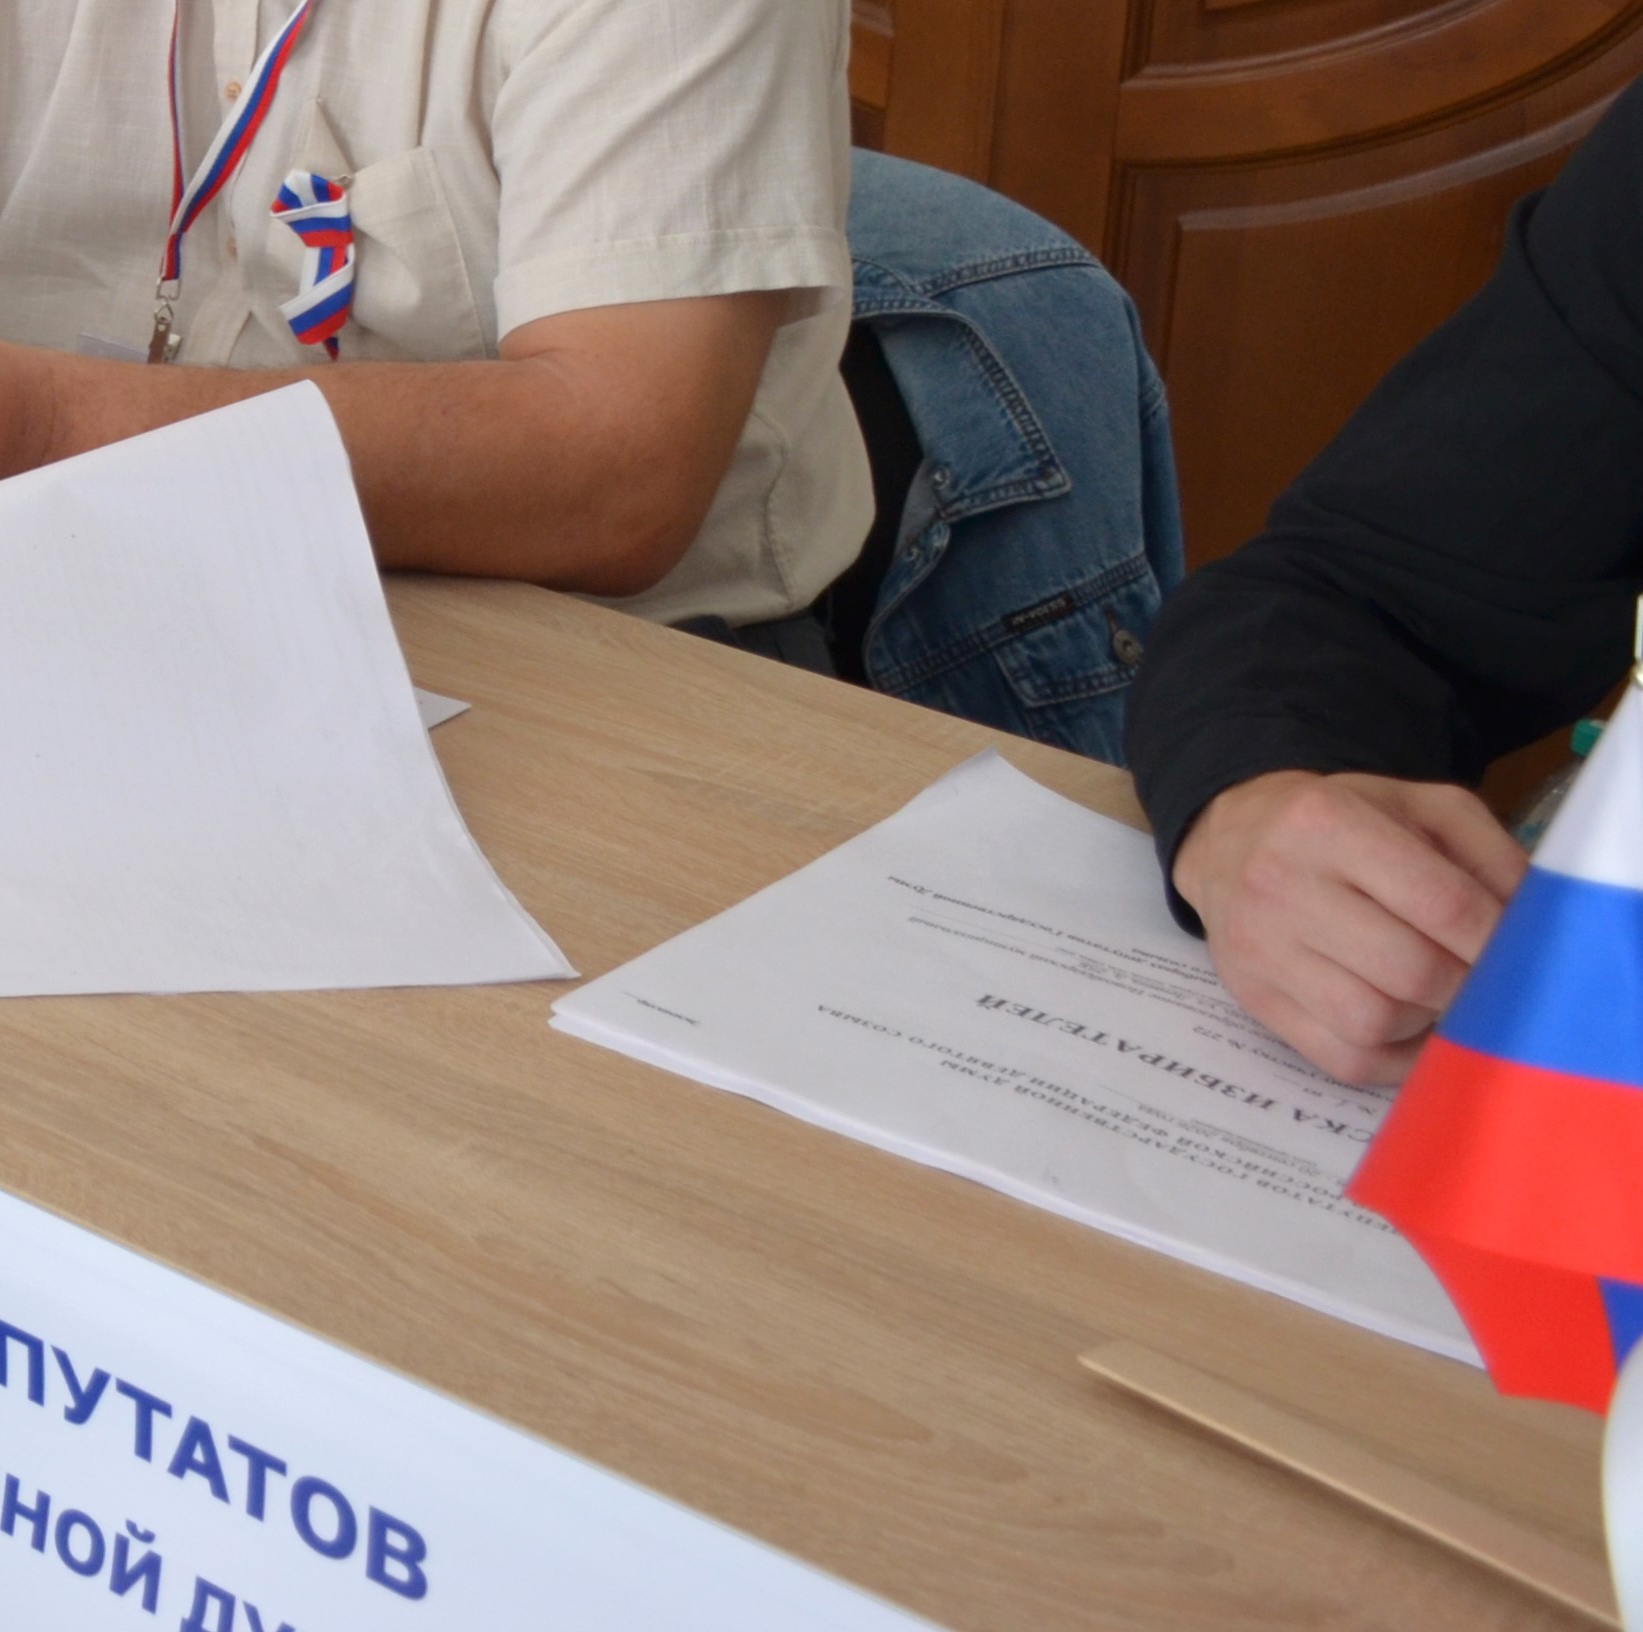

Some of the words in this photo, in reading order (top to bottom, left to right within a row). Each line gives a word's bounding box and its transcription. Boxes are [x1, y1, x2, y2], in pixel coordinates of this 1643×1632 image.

[817, 1004, 902, 1038] СОЗЫВА
[908, 1035, 1027, 1079] ДЕВЯТОГО
[976, 994, 1277, 1110] ИЗБИРАТЕЛЕЙ
[940, 1059, 1011, 1087] ДУМЫ
[1029, 1077, 1169, 1137] ФЕДЕРАЦИИ
[1292, 1108, 1375, 1144] СКА
